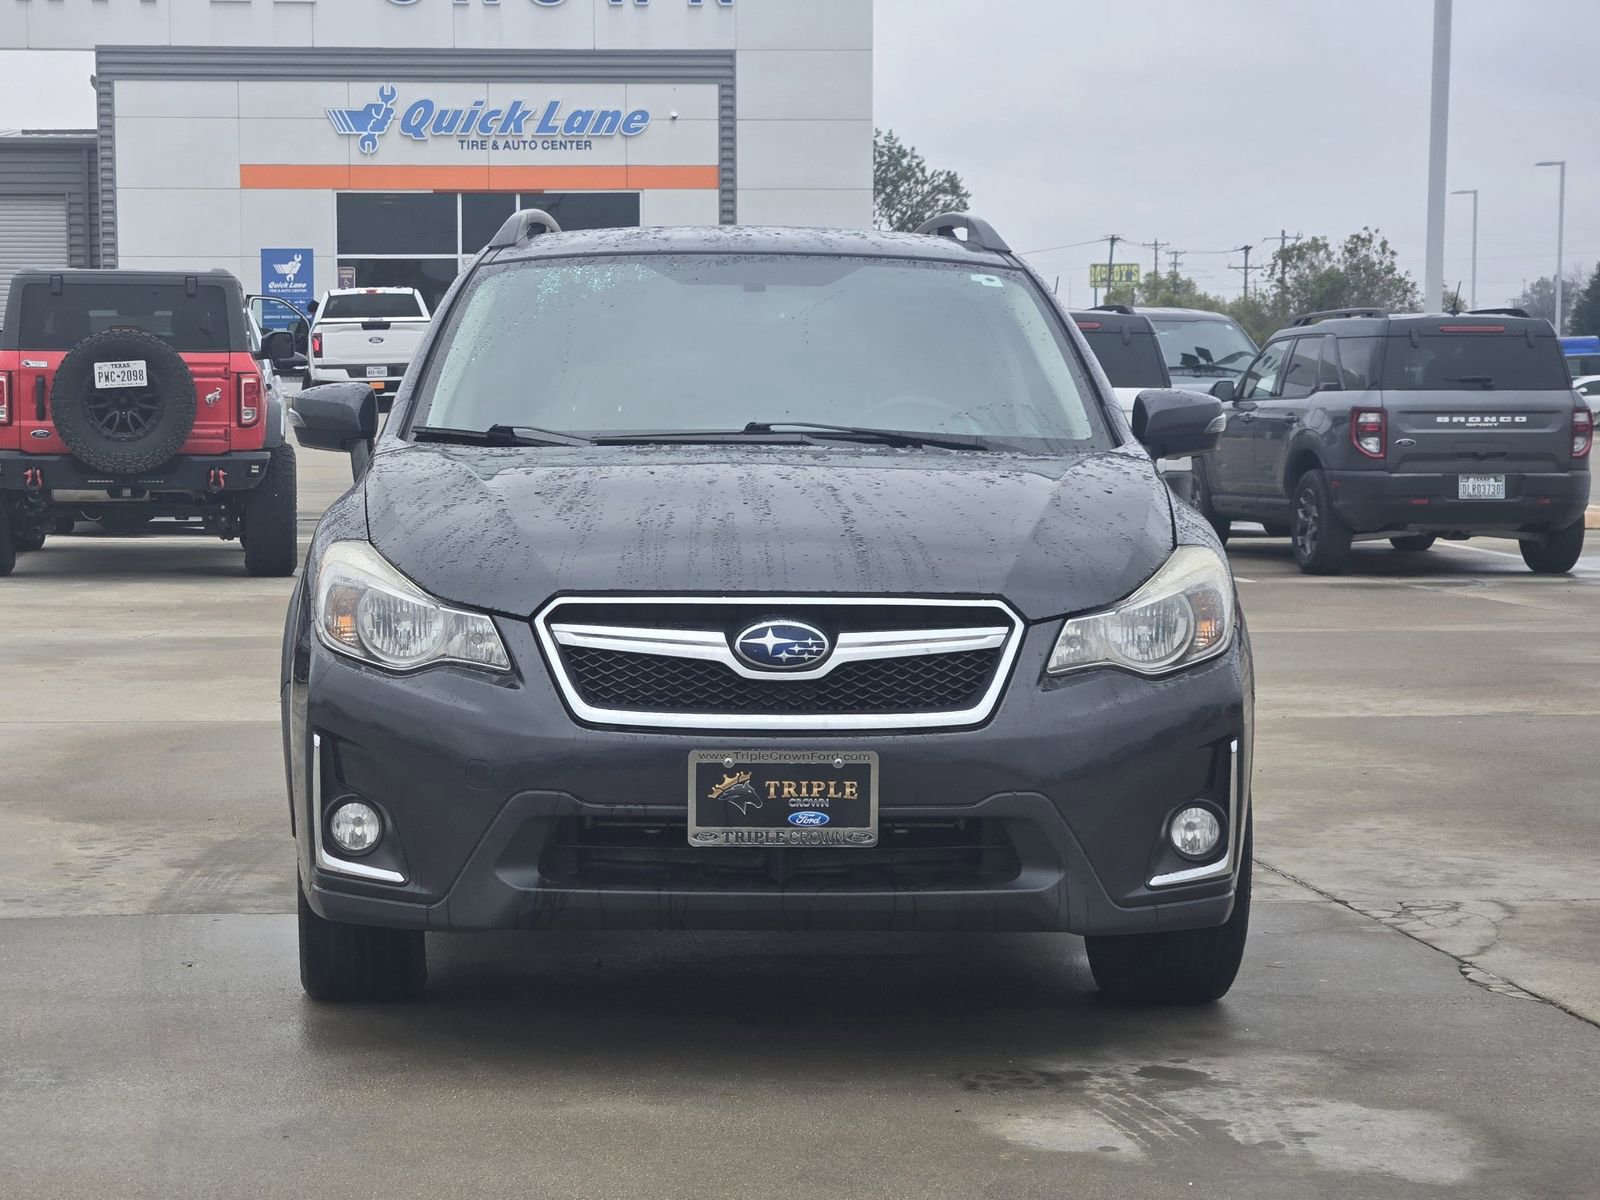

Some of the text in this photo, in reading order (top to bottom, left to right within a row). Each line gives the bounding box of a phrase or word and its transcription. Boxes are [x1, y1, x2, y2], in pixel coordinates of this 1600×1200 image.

[399, 98, 651, 141] Quick Lane
[458, 139, 593, 151] TIRE & AUTO CENTER
[268, 281, 307, 289] Quick Lane
[97, 369, 145, 384] PWC-2098
[698, 750, 871, 762] www.TripleCrownFord.com
[765, 780, 858, 800] TRIPLE
[788, 798, 830, 808] CROWN
[795, 813, 822, 825] Ford
[721, 831, 785, 845] TRIPLE
[789, 831, 846, 845] CROWN
